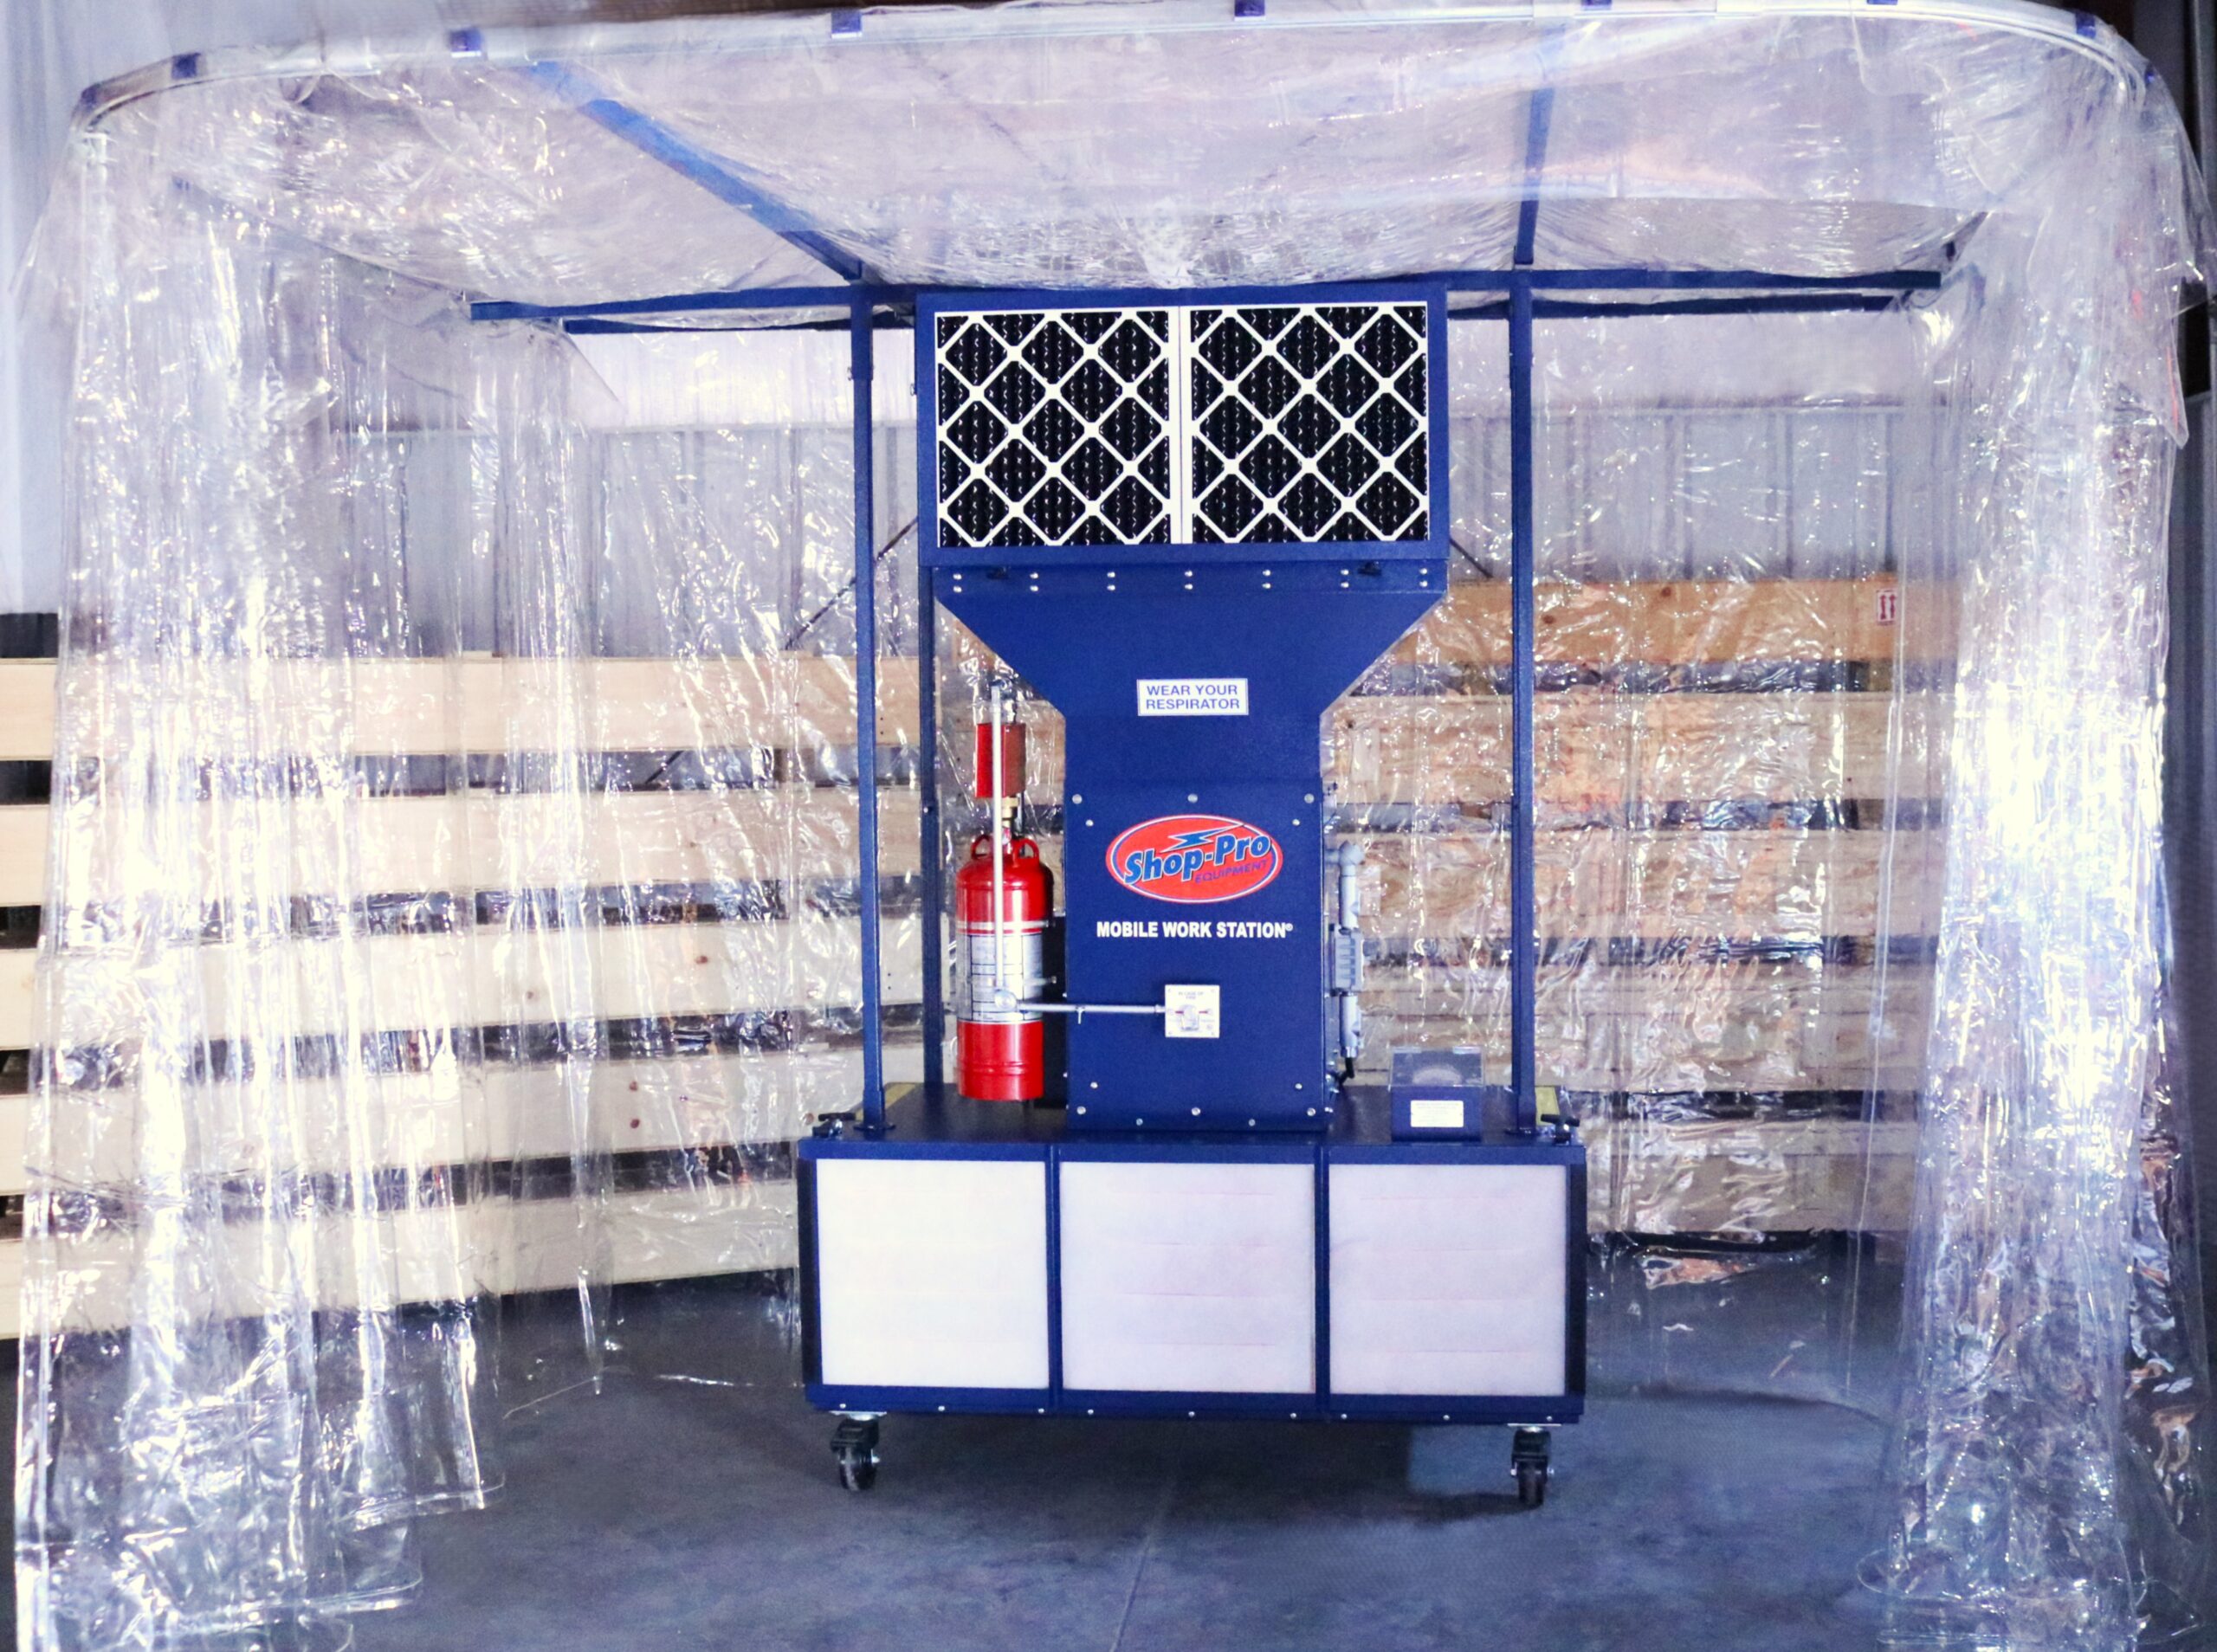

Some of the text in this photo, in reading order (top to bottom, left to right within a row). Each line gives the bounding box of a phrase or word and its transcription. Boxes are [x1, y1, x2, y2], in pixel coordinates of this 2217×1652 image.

[1147, 684, 1238, 696] WEAR YOUR
[1146, 699, 1239, 710] RESPIRATOR
[1124, 834, 1271, 885] Shop-Pro
[1195, 860, 1268, 884] EQUIPMENT
[1096, 920, 1159, 938] MOBILE
[1162, 921, 1212, 938] WORK
